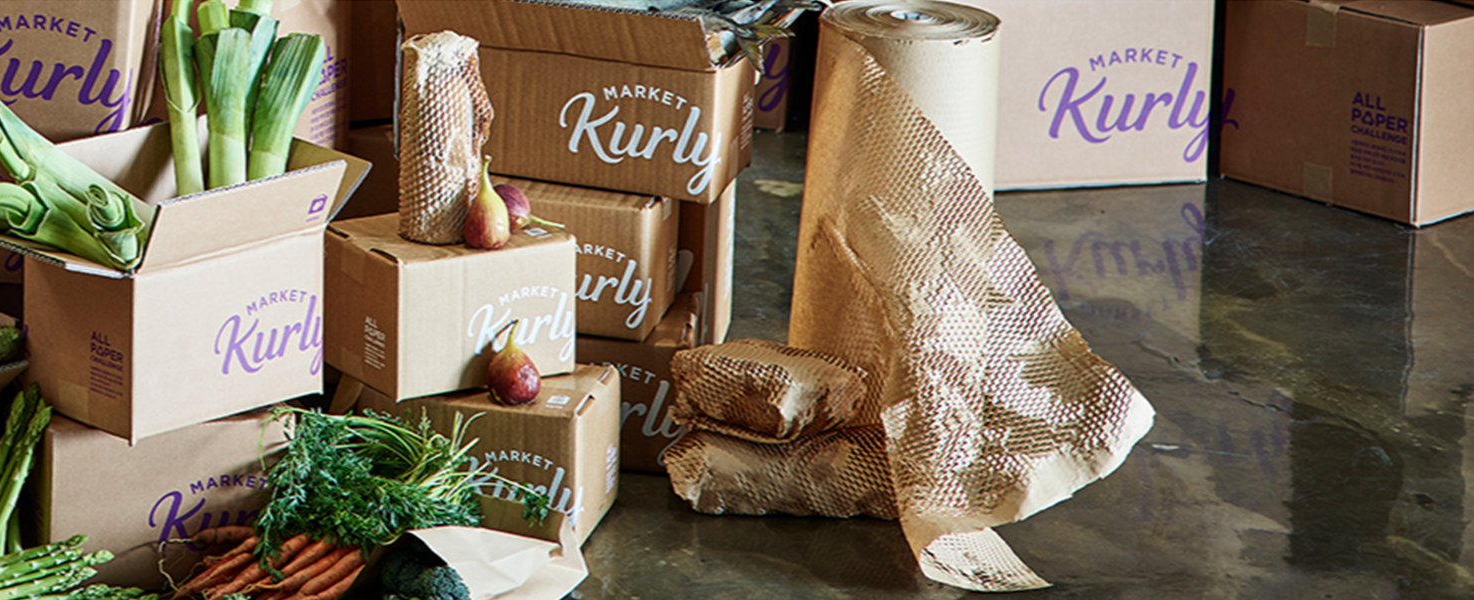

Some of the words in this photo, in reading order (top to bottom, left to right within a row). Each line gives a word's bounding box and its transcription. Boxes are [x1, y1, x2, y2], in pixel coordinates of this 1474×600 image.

[1089, 48, 1183, 71] MARKET
[603, 84, 688, 110] MARKET
[1352, 91, 1386, 111] ALL
[1038, 62, 1210, 163] Kurly
[559, 92, 722, 195] Kurly
[574, 243, 626, 263] ARKET
[246, 289, 307, 316] MARKET
[498, 285, 559, 306] MARKET
[574, 260, 653, 329] urly
[214, 295, 324, 375] Kurly
[485, 450, 554, 471] MARKET
[190, 475, 268, 494] MARKET
